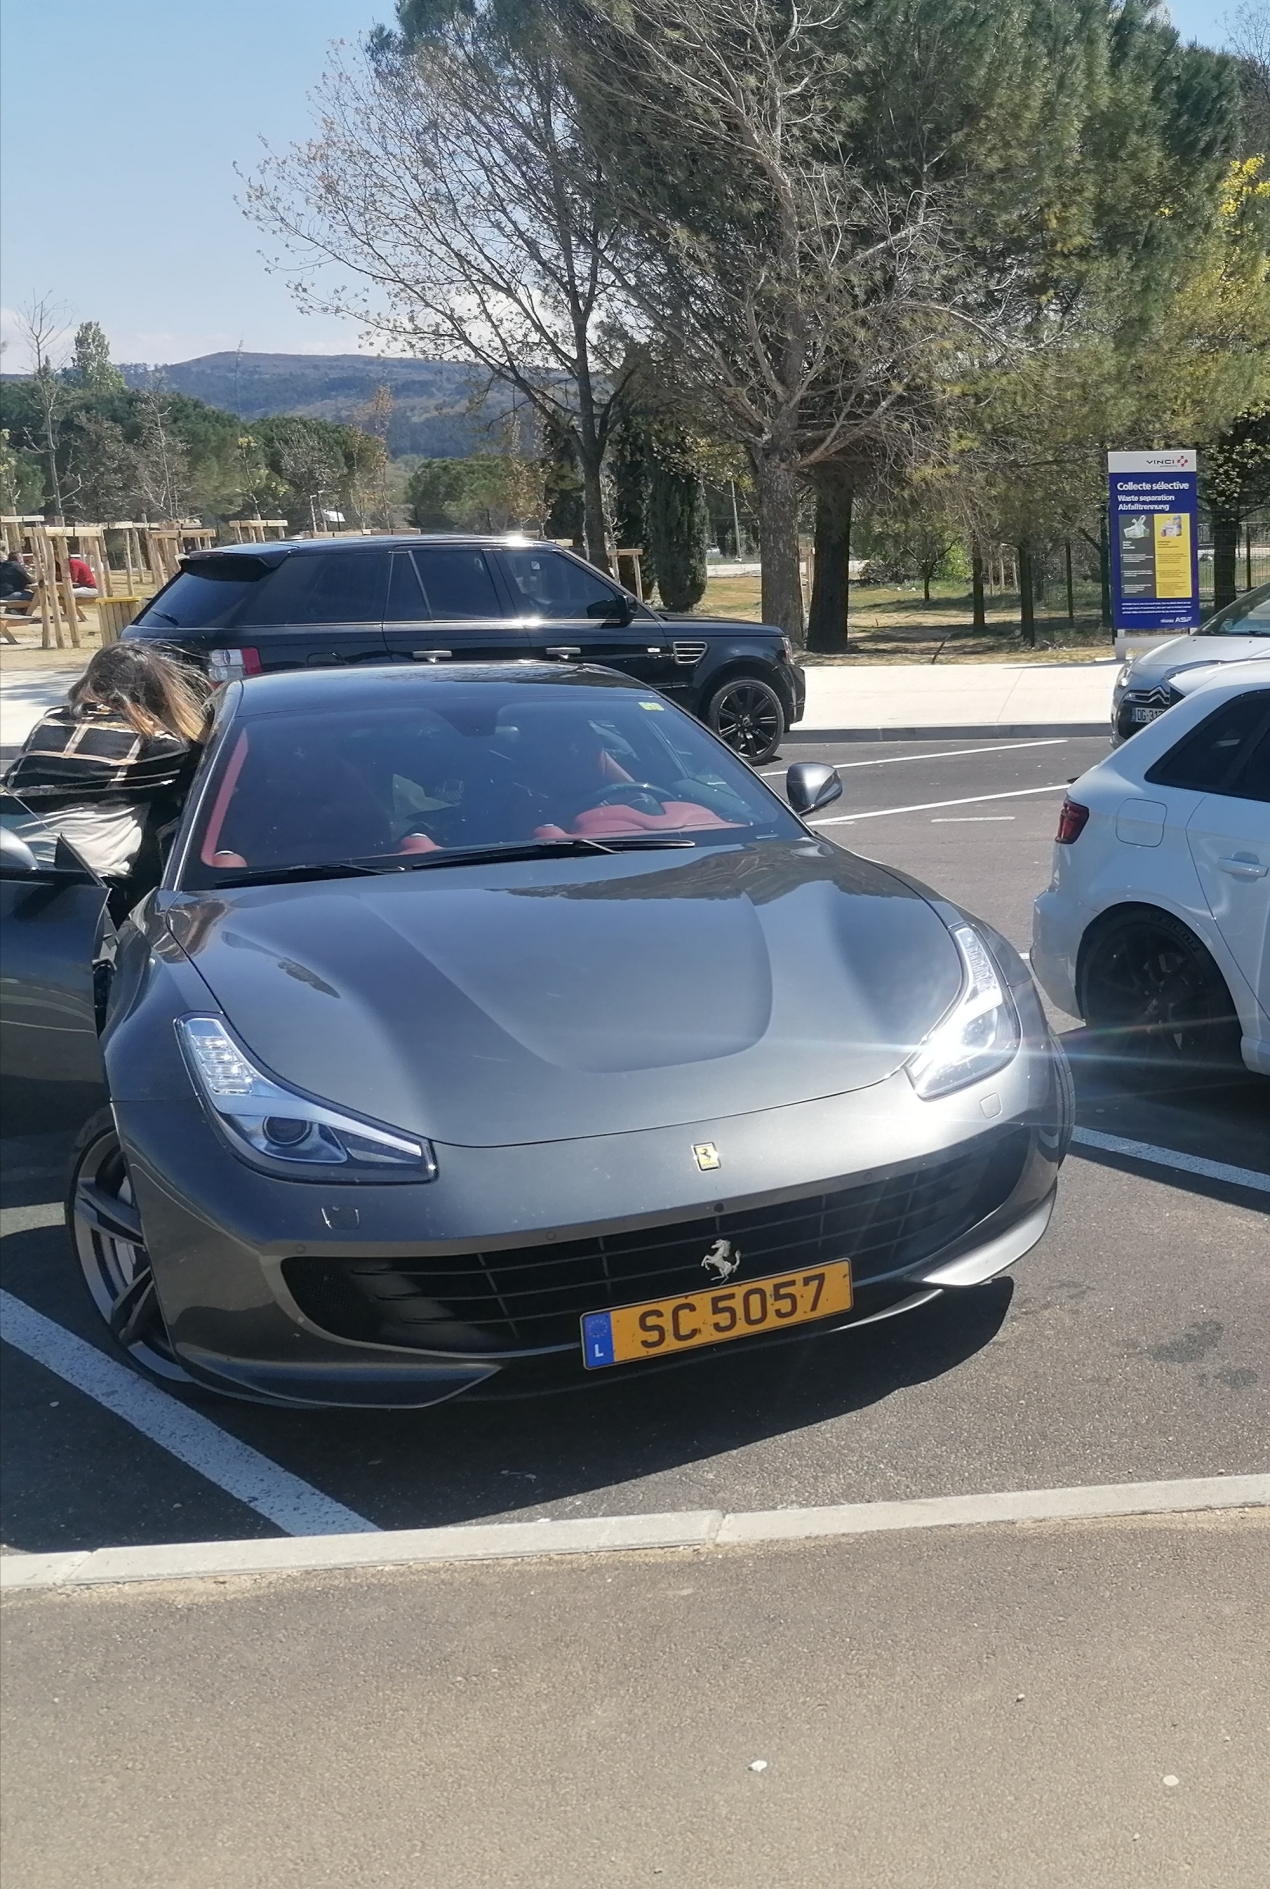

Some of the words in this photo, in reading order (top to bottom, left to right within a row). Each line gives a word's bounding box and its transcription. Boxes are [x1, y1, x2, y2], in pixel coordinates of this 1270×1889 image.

[1117, 482, 1151, 490] Collecte
[1152, 481, 1189, 490] sélective
[1139, 494, 1175, 502] separation
[1118, 503, 1170, 511] Abfalltrennung
[638, 1302, 698, 1349] SC
[710, 1272, 826, 1333] 5057
[594, 1344, 604, 1358] L
